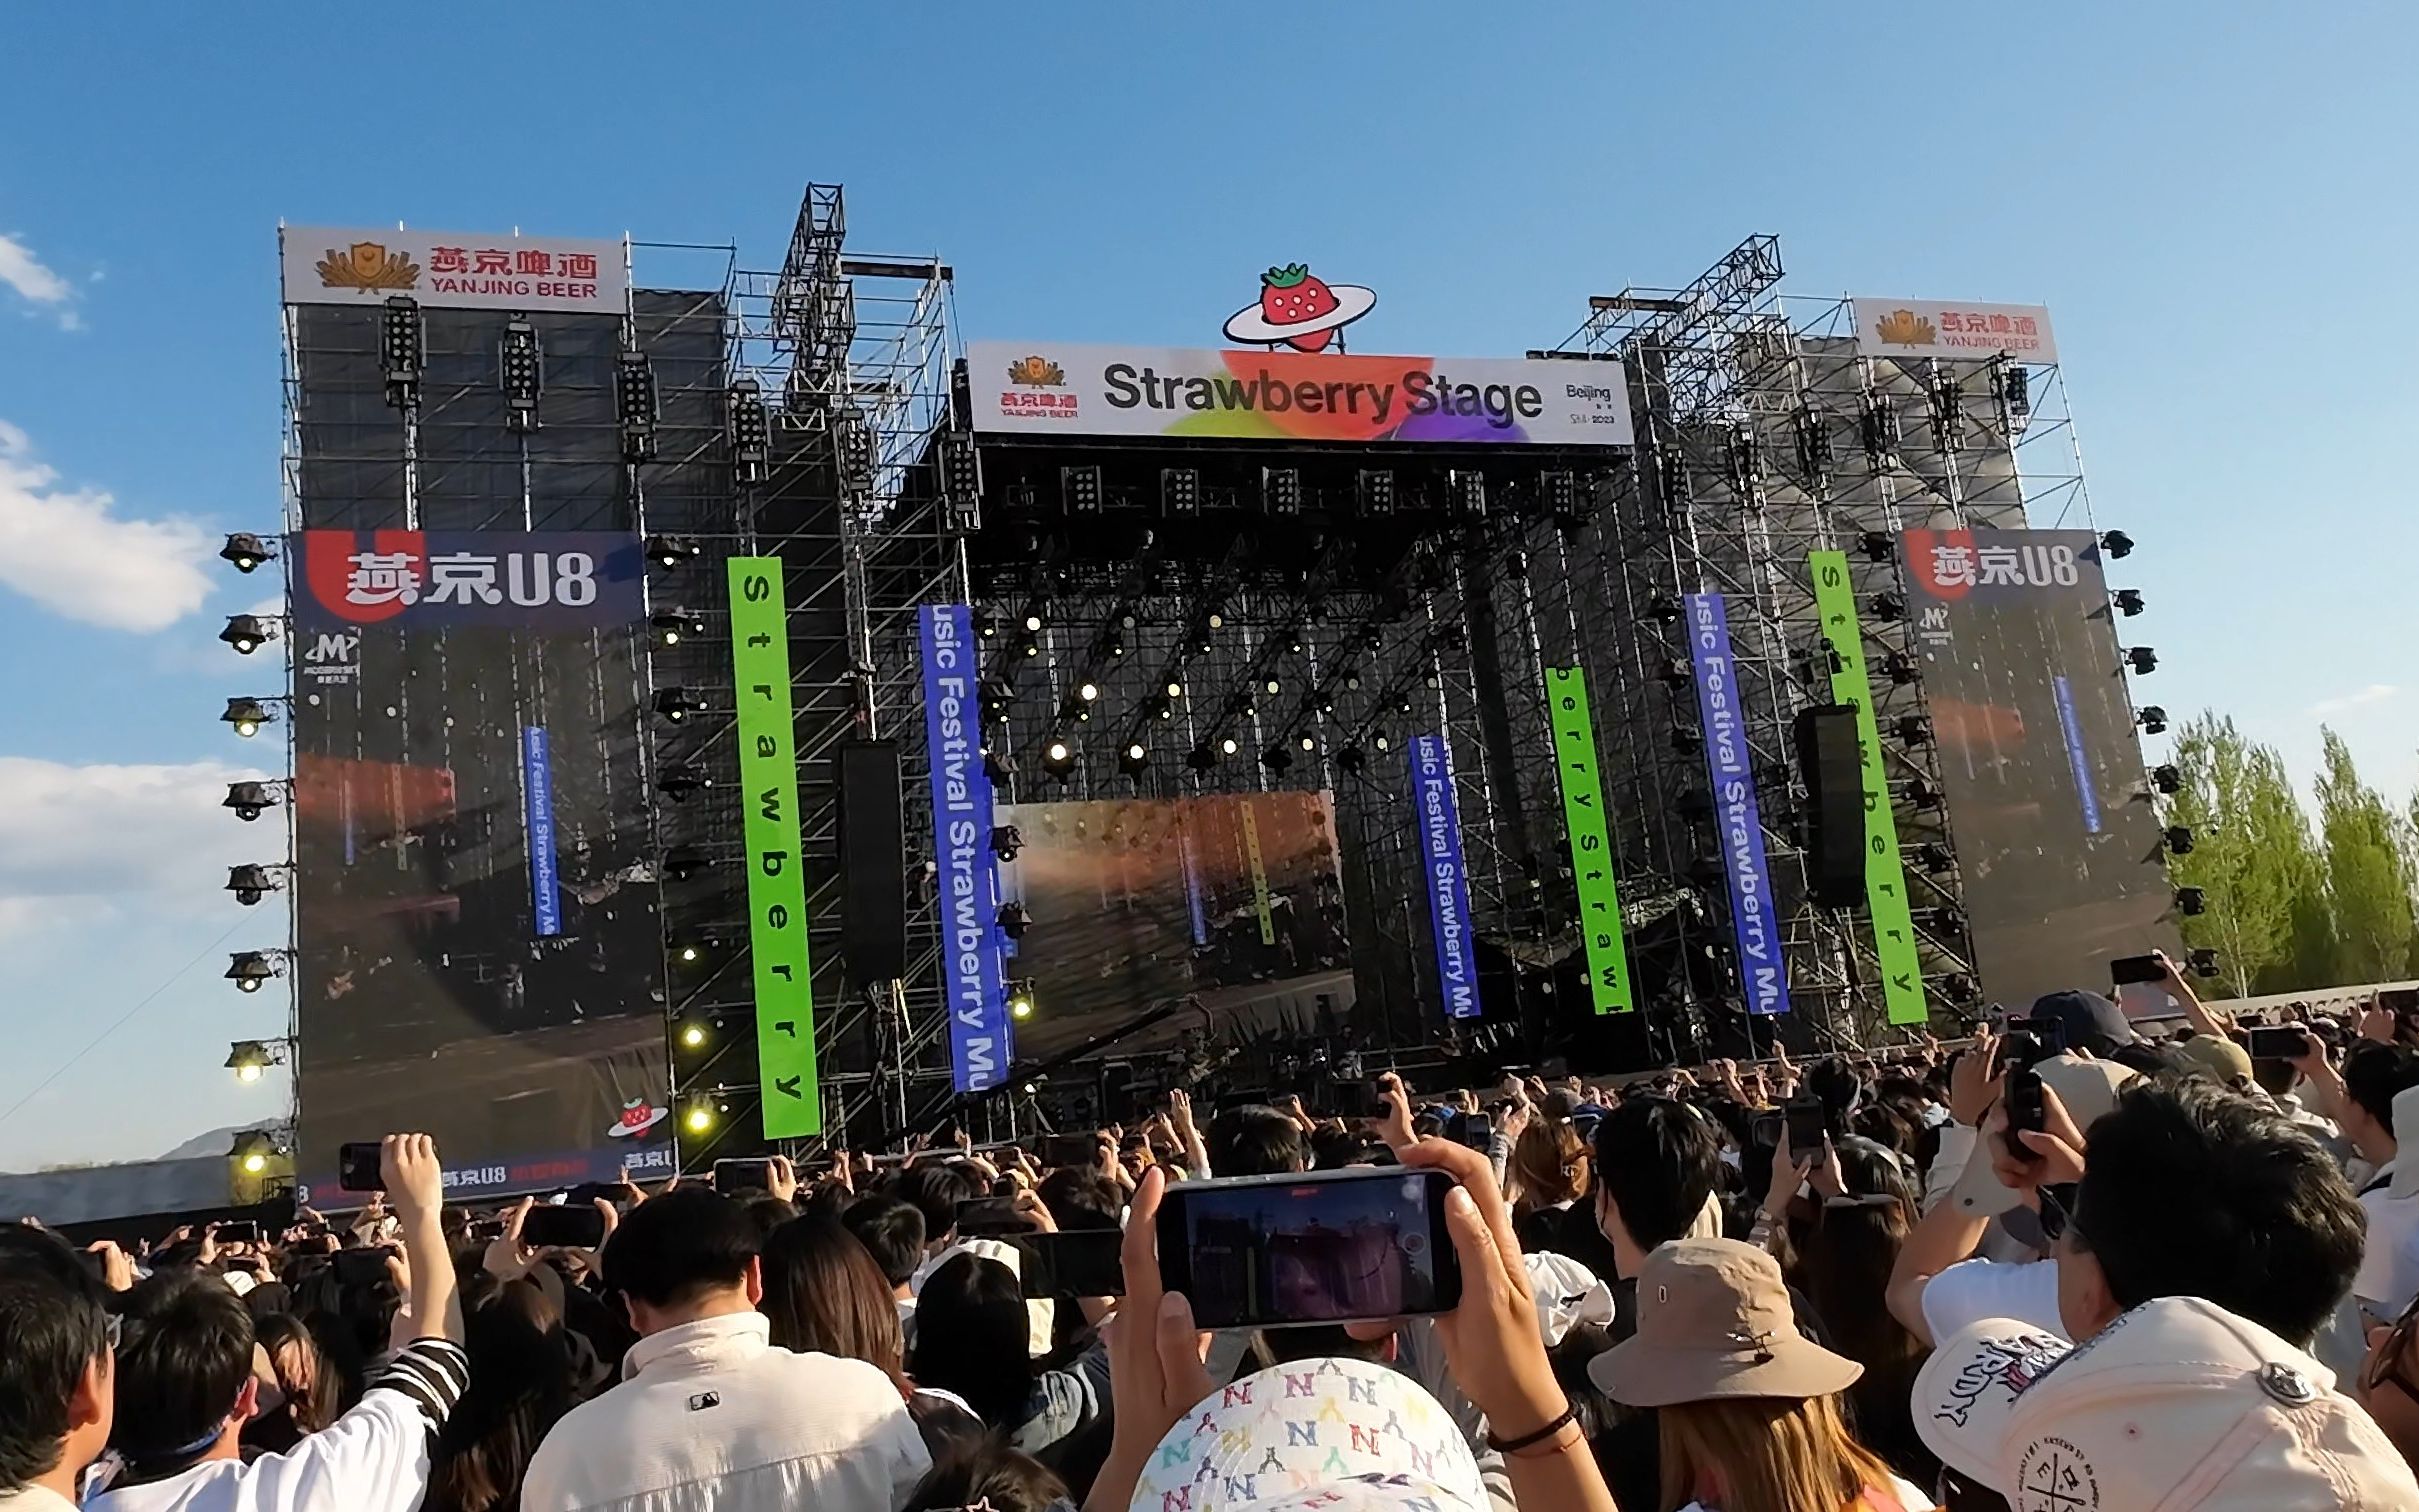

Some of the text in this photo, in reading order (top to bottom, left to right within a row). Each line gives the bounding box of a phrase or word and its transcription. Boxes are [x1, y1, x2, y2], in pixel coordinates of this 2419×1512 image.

[430, 246, 598, 280] 燕京啤酒
[431, 279, 598, 299] YANJING BEER
[1939, 312, 2038, 336] 燕京啤酒
[1943, 335, 2040, 351] YANJING BEER
[1104, 363, 1543, 429] Strawberry Stage
[1566, 384, 1611, 402] Beijing
[344, 551, 597, 606] 燕京U8
[1931, 545, 2079, 587] 燕京U8
[938, 677, 974, 810] Festival
[1424, 778, 1451, 858] Festival
[1704, 657, 1741, 772] Festival
[1725, 781, 1767, 960] Strawberry
[949, 821, 985, 1029] Strawberry
[1435, 862, 1465, 984] Strawberry
[1285, 1373, 1315, 1398] N
[1286, 1421, 1318, 1446] N
[1349, 1423, 1382, 1457] N
